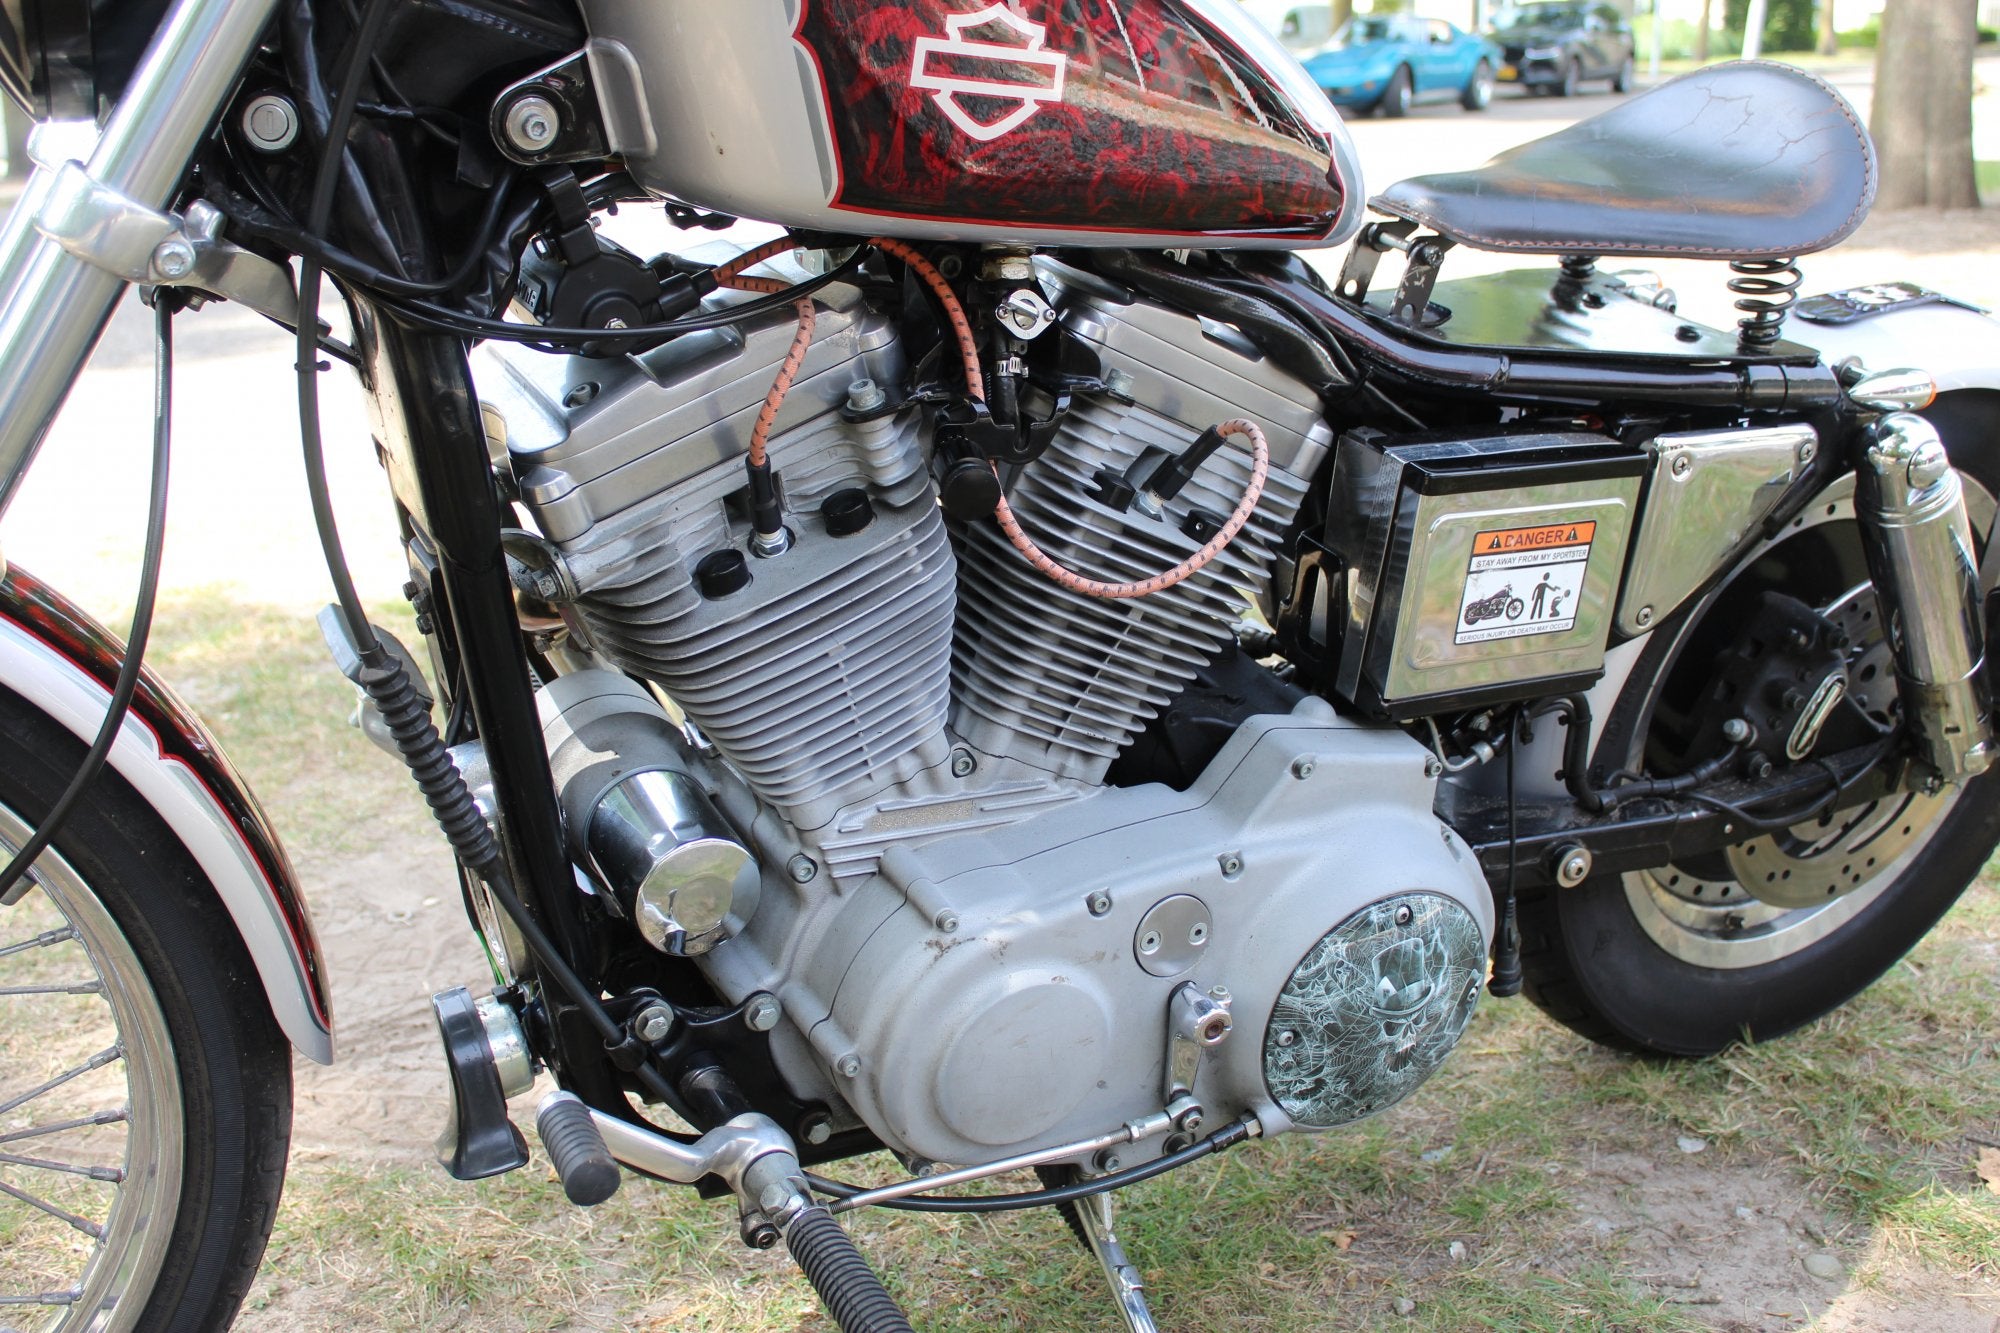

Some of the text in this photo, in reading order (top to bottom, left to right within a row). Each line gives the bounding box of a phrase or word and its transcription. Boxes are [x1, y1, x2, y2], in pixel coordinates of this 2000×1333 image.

[1504, 530, 1564, 547] DANGER
[1476, 549, 1587, 568] STAY AWAY FROM MY SPORTSTER
[1460, 622, 1570, 642] SERIOUS INJURY OR DEATH MAY OCCUR
